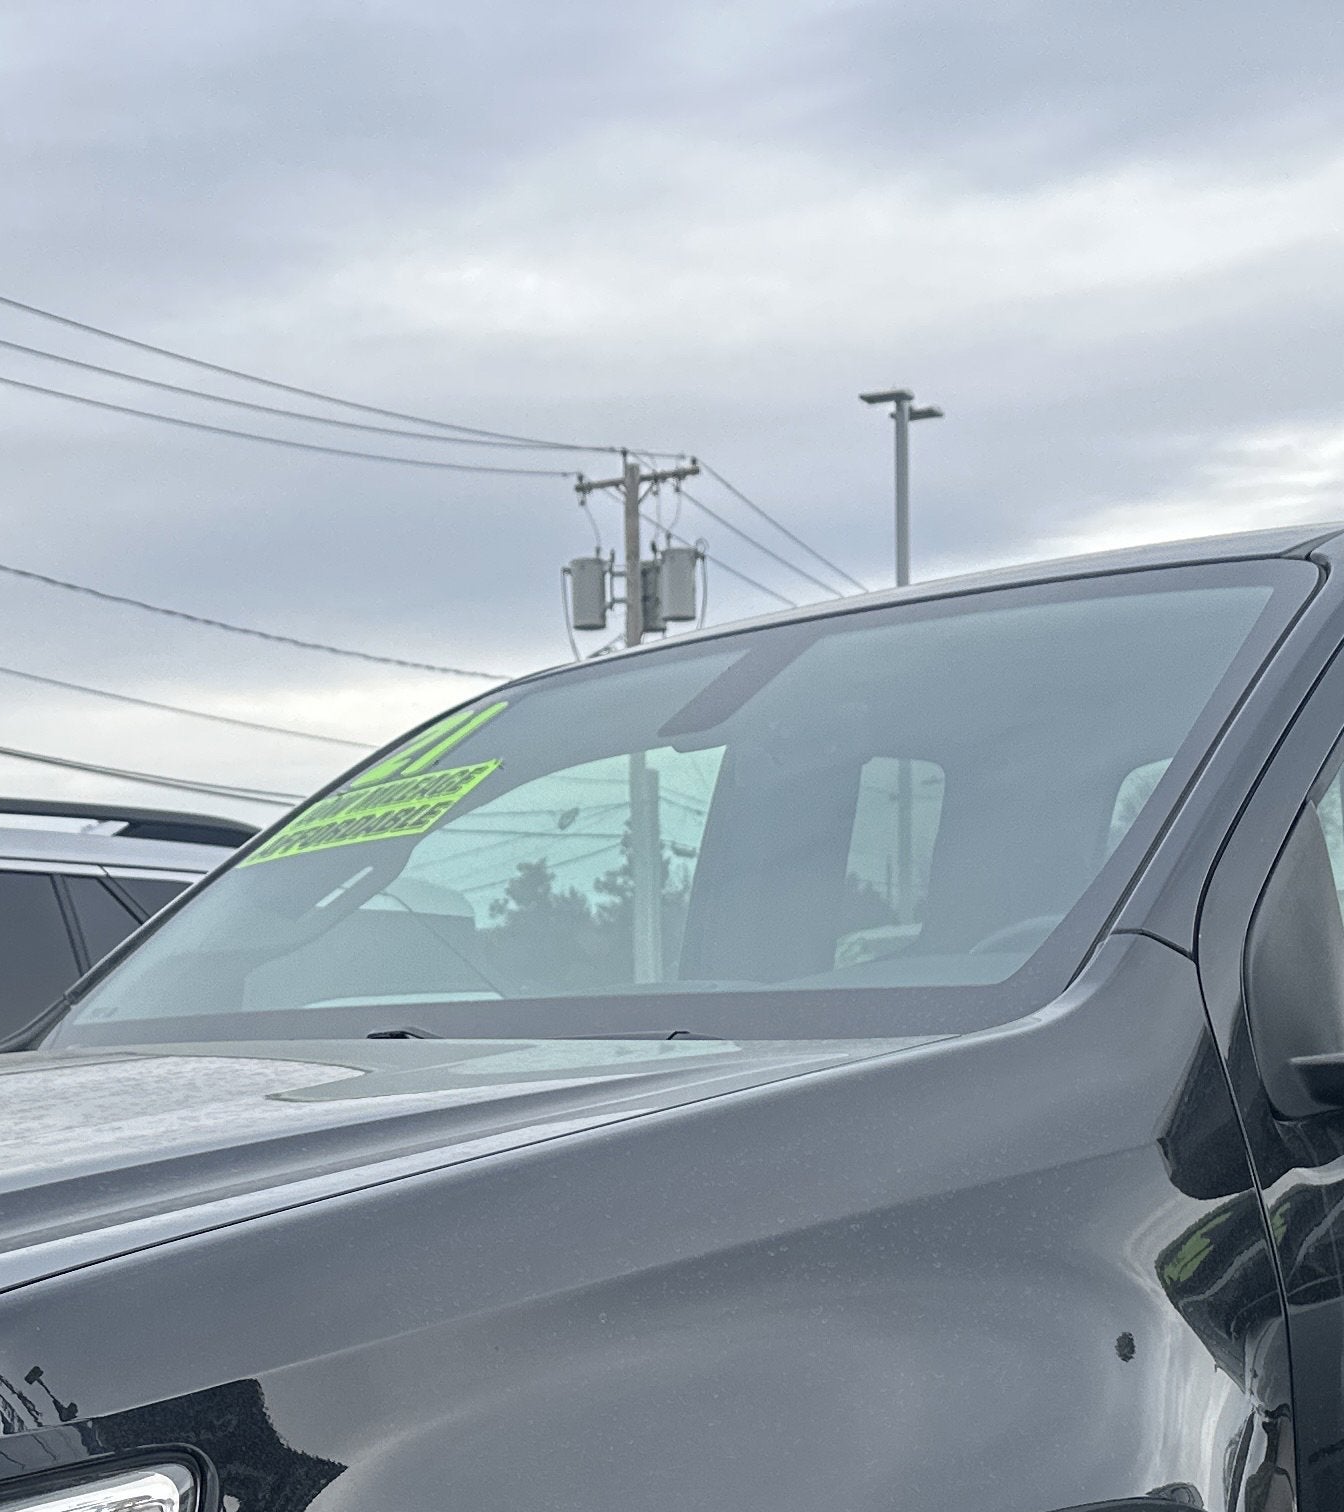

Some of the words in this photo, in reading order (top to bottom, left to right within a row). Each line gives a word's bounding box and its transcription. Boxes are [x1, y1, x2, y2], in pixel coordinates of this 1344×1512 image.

[351, 702, 509, 787] 21
[346, 763, 490, 816] MILEAGE
[251, 799, 454, 860] AFFORDABLE
